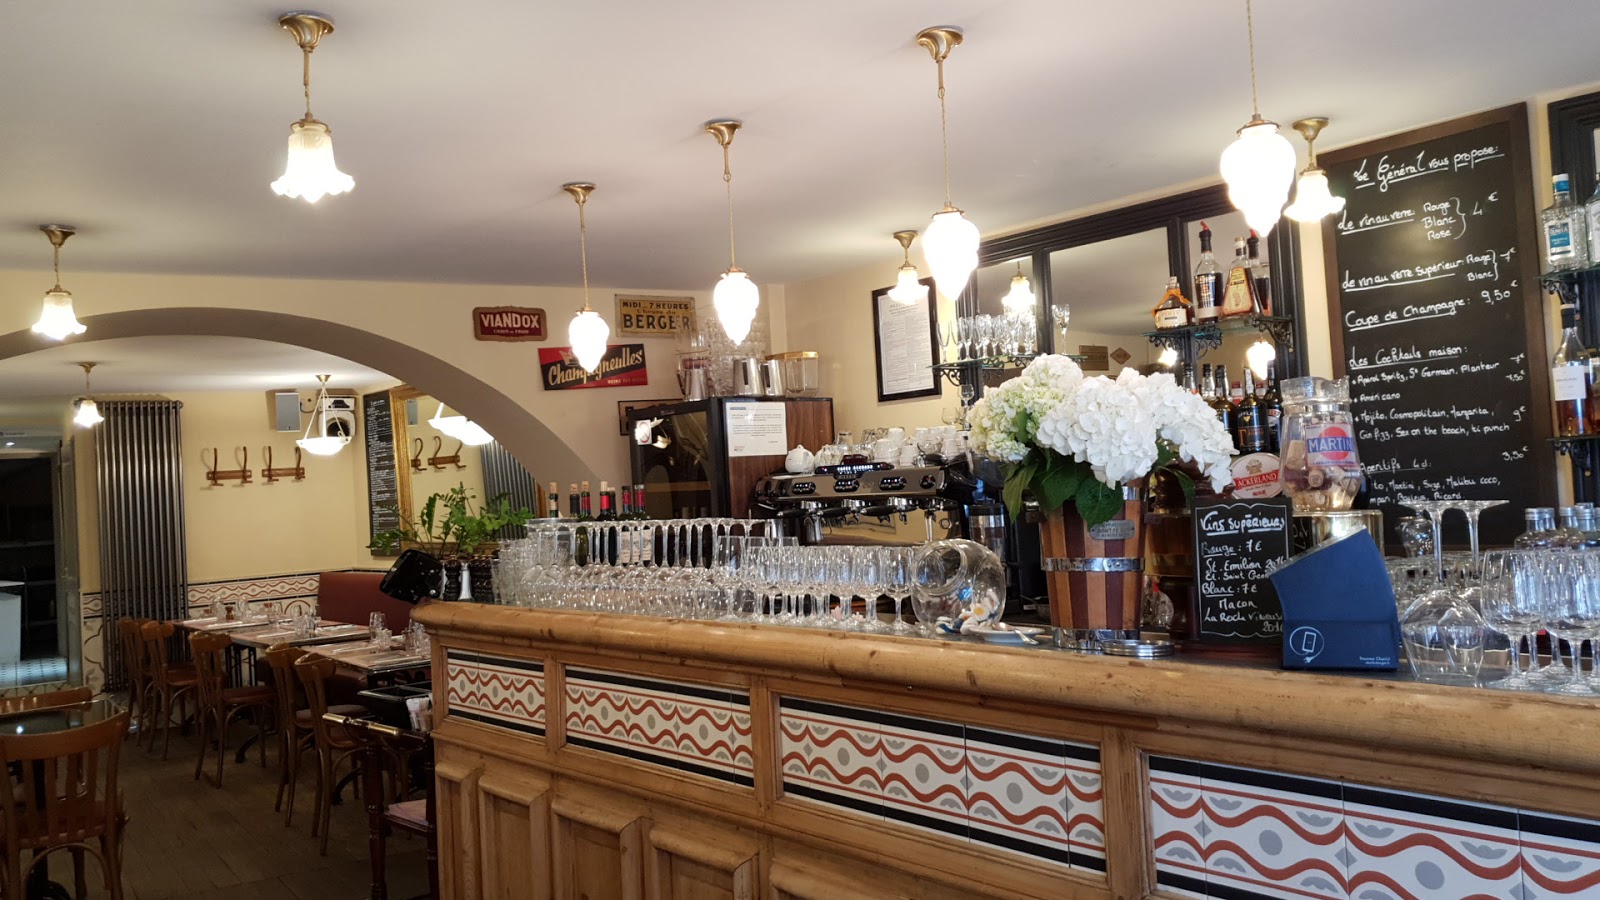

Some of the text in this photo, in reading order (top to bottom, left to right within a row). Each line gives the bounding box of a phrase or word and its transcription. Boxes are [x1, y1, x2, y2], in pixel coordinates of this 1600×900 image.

[1353, 158, 1370, 182] Le
[1376, 150, 1426, 193] Général
[1428, 156, 1449, 169] vous
[1423, 201, 1451, 216] Rouge
[1337, 209, 1354, 231] Le
[1376, 214, 1390, 224] au
[1421, 215, 1457, 229] Blanc
[1466, 254, 1492, 266] Rouge
[1342, 269, 1355, 289] Le
[1374, 275, 1389, 283] au
[1390, 269, 1414, 280] verre
[1466, 272, 1494, 282] Blanc
[656, 302, 689, 310] HEURES
[480, 313, 540, 329] VIANDOX
[623, 313, 690, 330] BERGER
[1345, 310, 1380, 329] Coupe
[1384, 310, 1398, 321] de
[1349, 346, 1369, 368] Les
[1460, 361, 1500, 374] Planteur
[1359, 429, 1373, 440] Gin
[1410, 428, 1421, 436] on
[1423, 425, 1438, 436] the
[1471, 423, 1481, 433] ti
[1483, 422, 1510, 435] punch
[1308, 437, 1354, 452] MARTIN
[1237, 472, 1278, 488] ACKERLAND
[1445, 475, 1476, 489] Malibu
[1200, 510, 1225, 532] Vins
[1222, 571, 1246, 581] Saint
[1218, 597, 1258, 611] Macon
[1204, 606, 1218, 622] La
